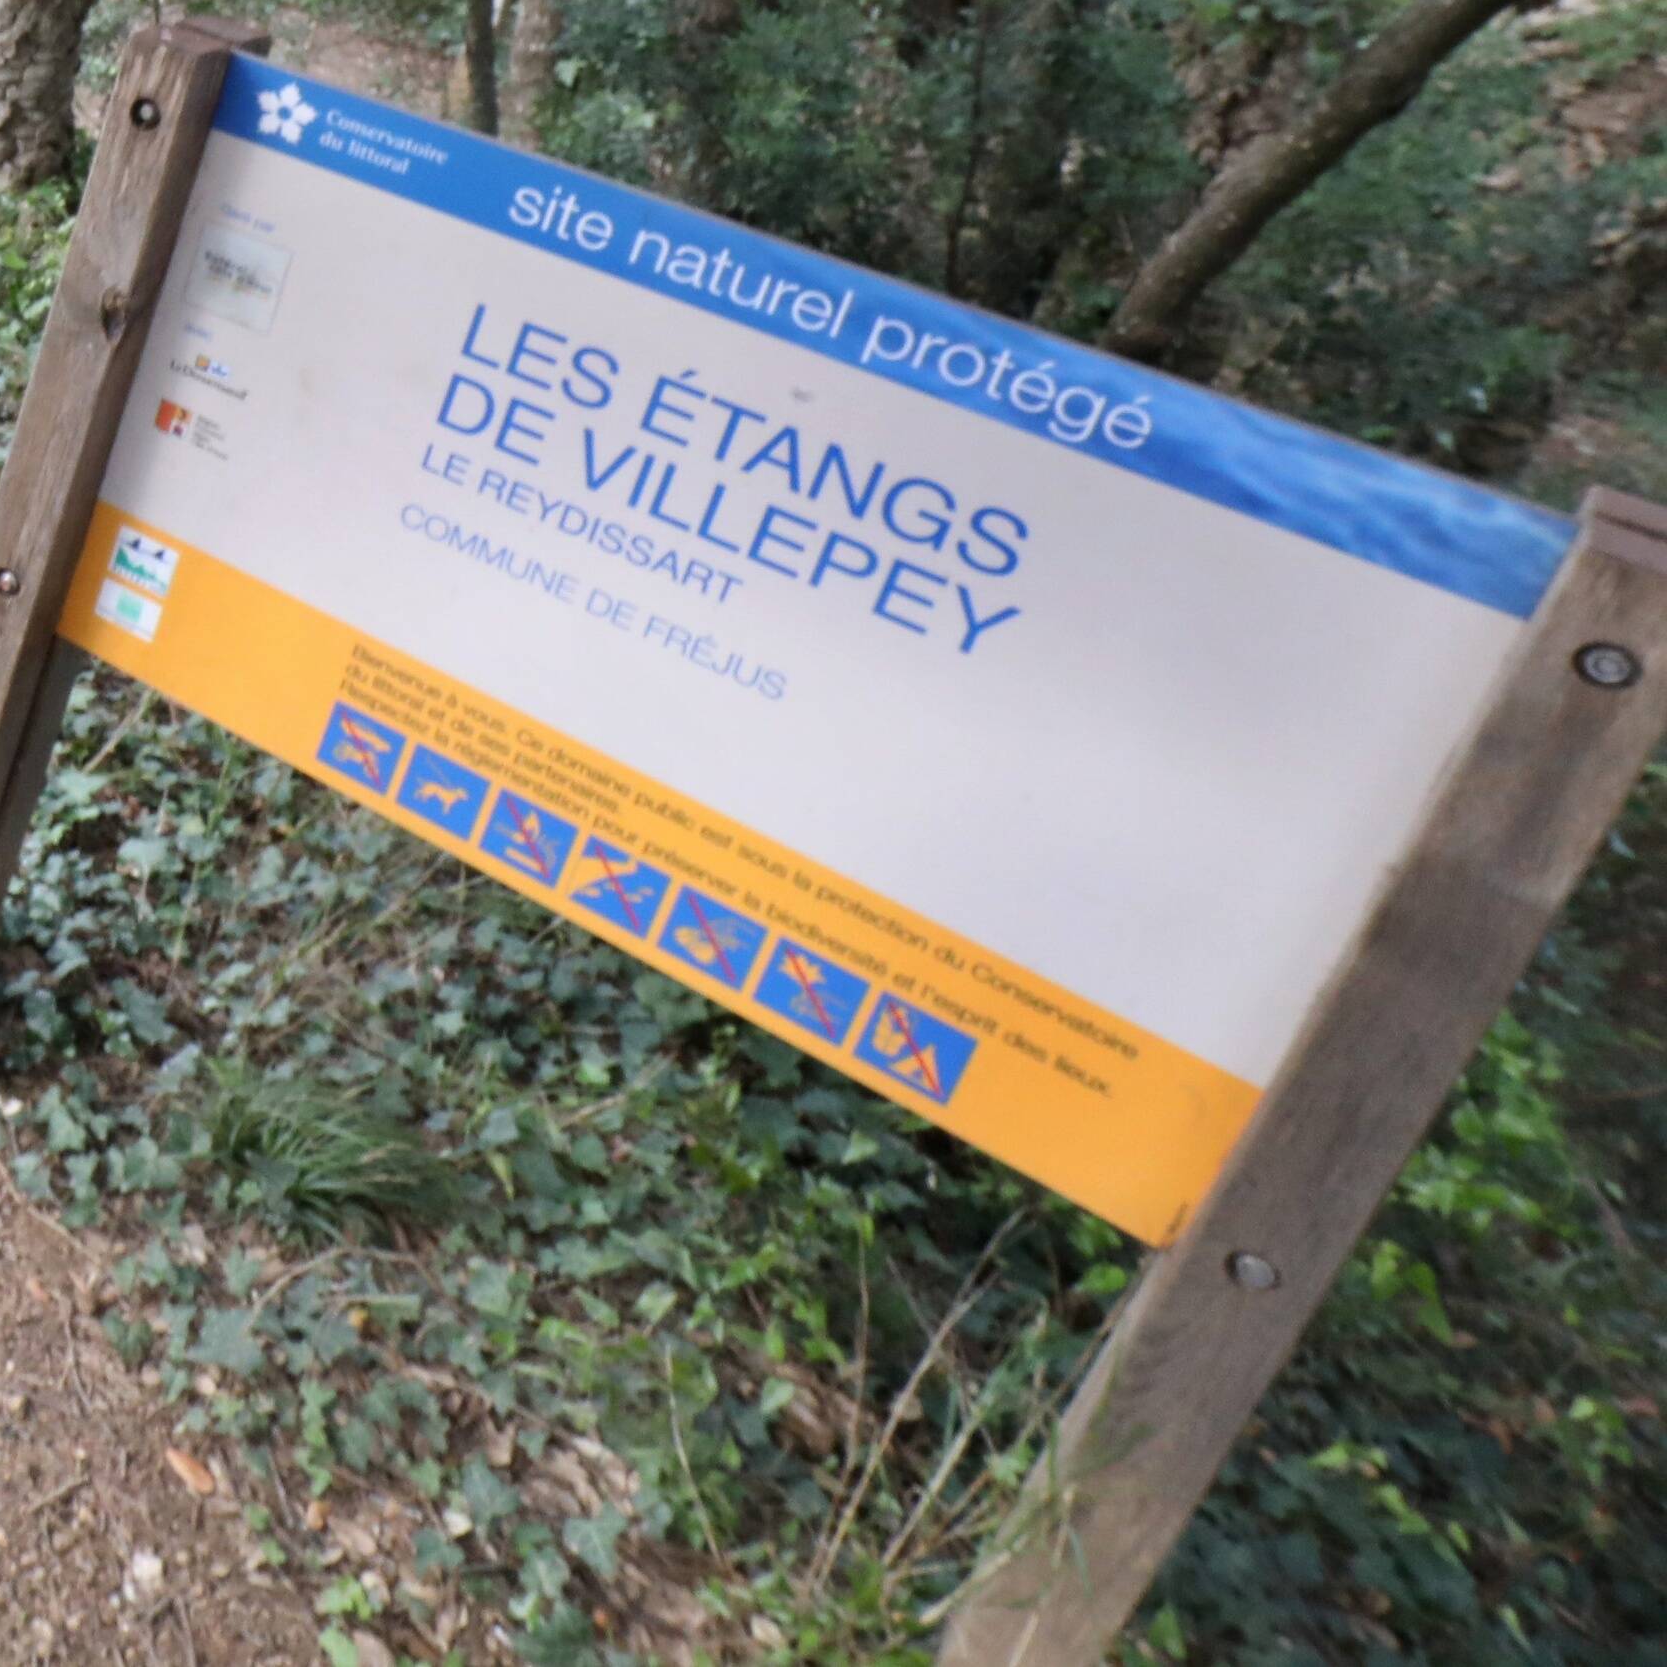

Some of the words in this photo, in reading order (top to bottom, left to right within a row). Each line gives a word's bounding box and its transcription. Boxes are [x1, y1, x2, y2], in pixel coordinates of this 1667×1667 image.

[319, 130, 344, 152] du
[347, 138, 411, 175] littoral
[327, 109, 449, 165] Conservatoire
[509, 185, 614, 251] site
[629, 229, 854, 338] naturel
[860, 315, 1153, 449] protégé
[421, 443, 471, 485] LE
[478, 468, 744, 603] REYDISSART
[437, 373, 556, 466] DE
[583, 427, 1022, 654] VILLEPEY
[461, 303, 619, 410] LES
[640, 369, 1028, 577] ÉTANGS
[400, 503, 578, 603] COMMUNE
[585, 588, 637, 631] DE
[643, 614, 788, 701] FRÉJUS
